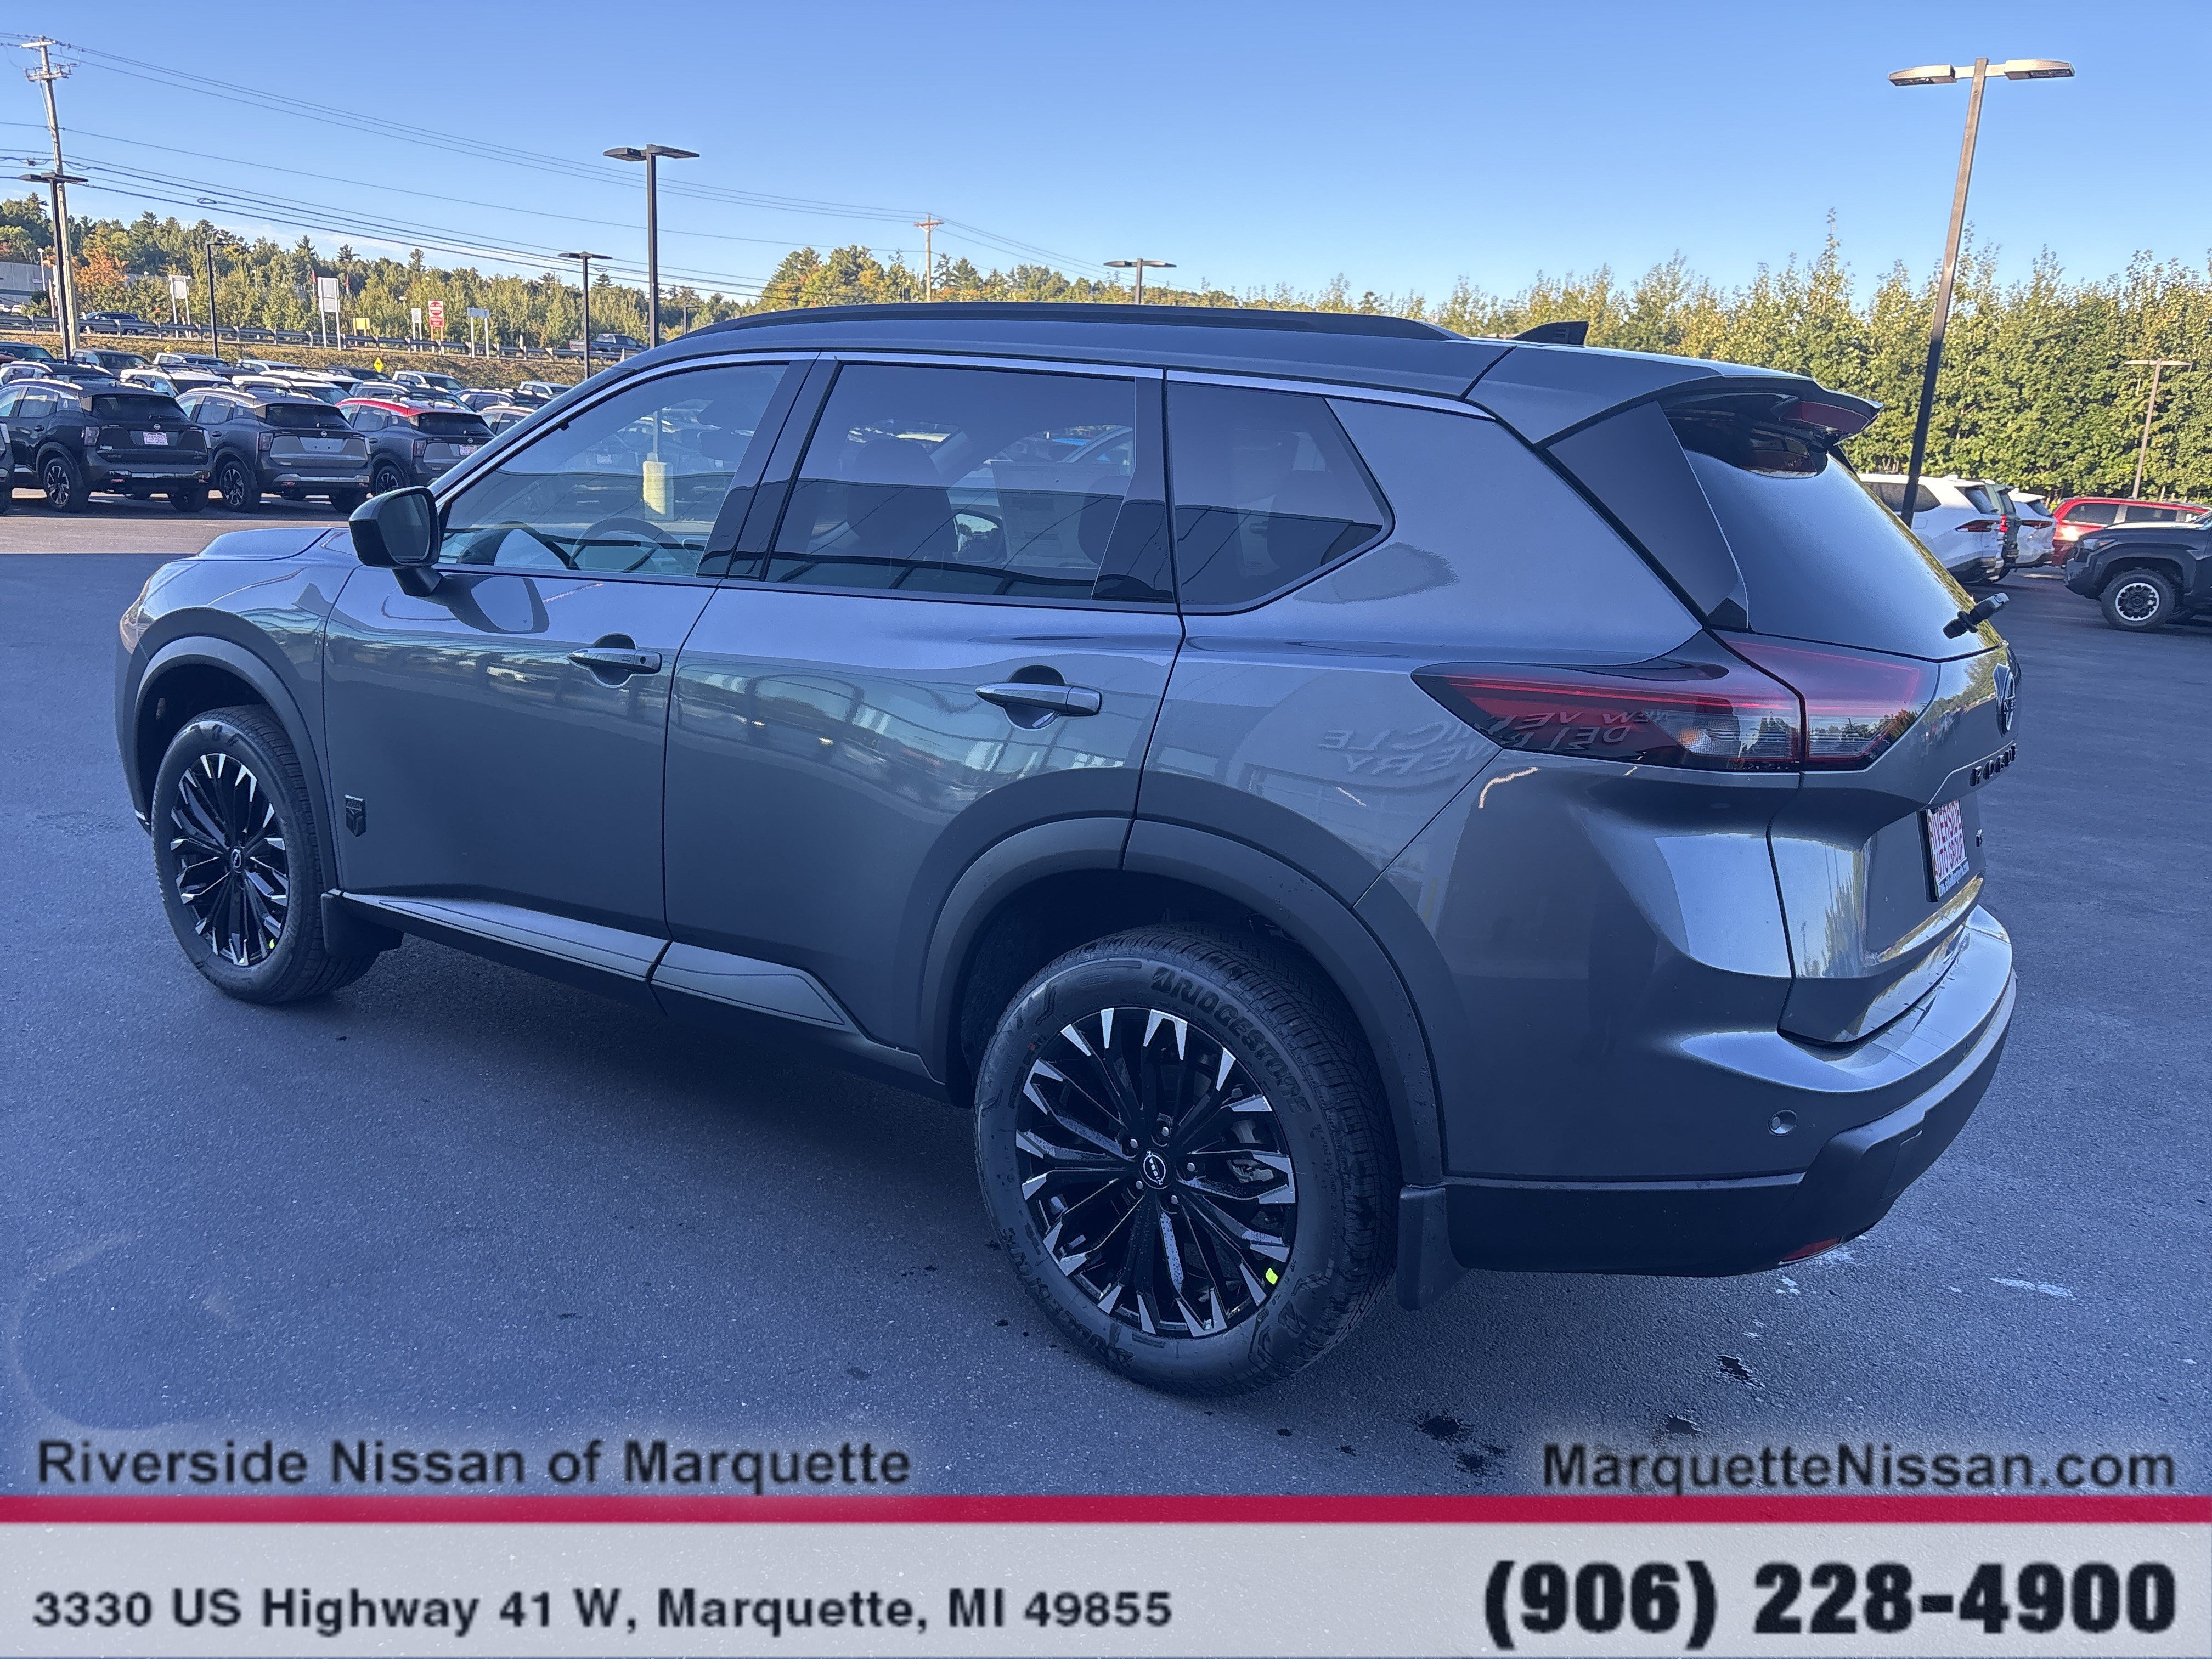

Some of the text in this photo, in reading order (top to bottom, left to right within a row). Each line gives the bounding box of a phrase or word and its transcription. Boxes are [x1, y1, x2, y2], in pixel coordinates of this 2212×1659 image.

[1927, 800, 1962, 850] RIVERSIDE
[1933, 845, 1949, 880] AUTO
[1948, 832, 1963, 870] GROUP
[1151, 966, 1312, 1114] BRIDGESTONE
